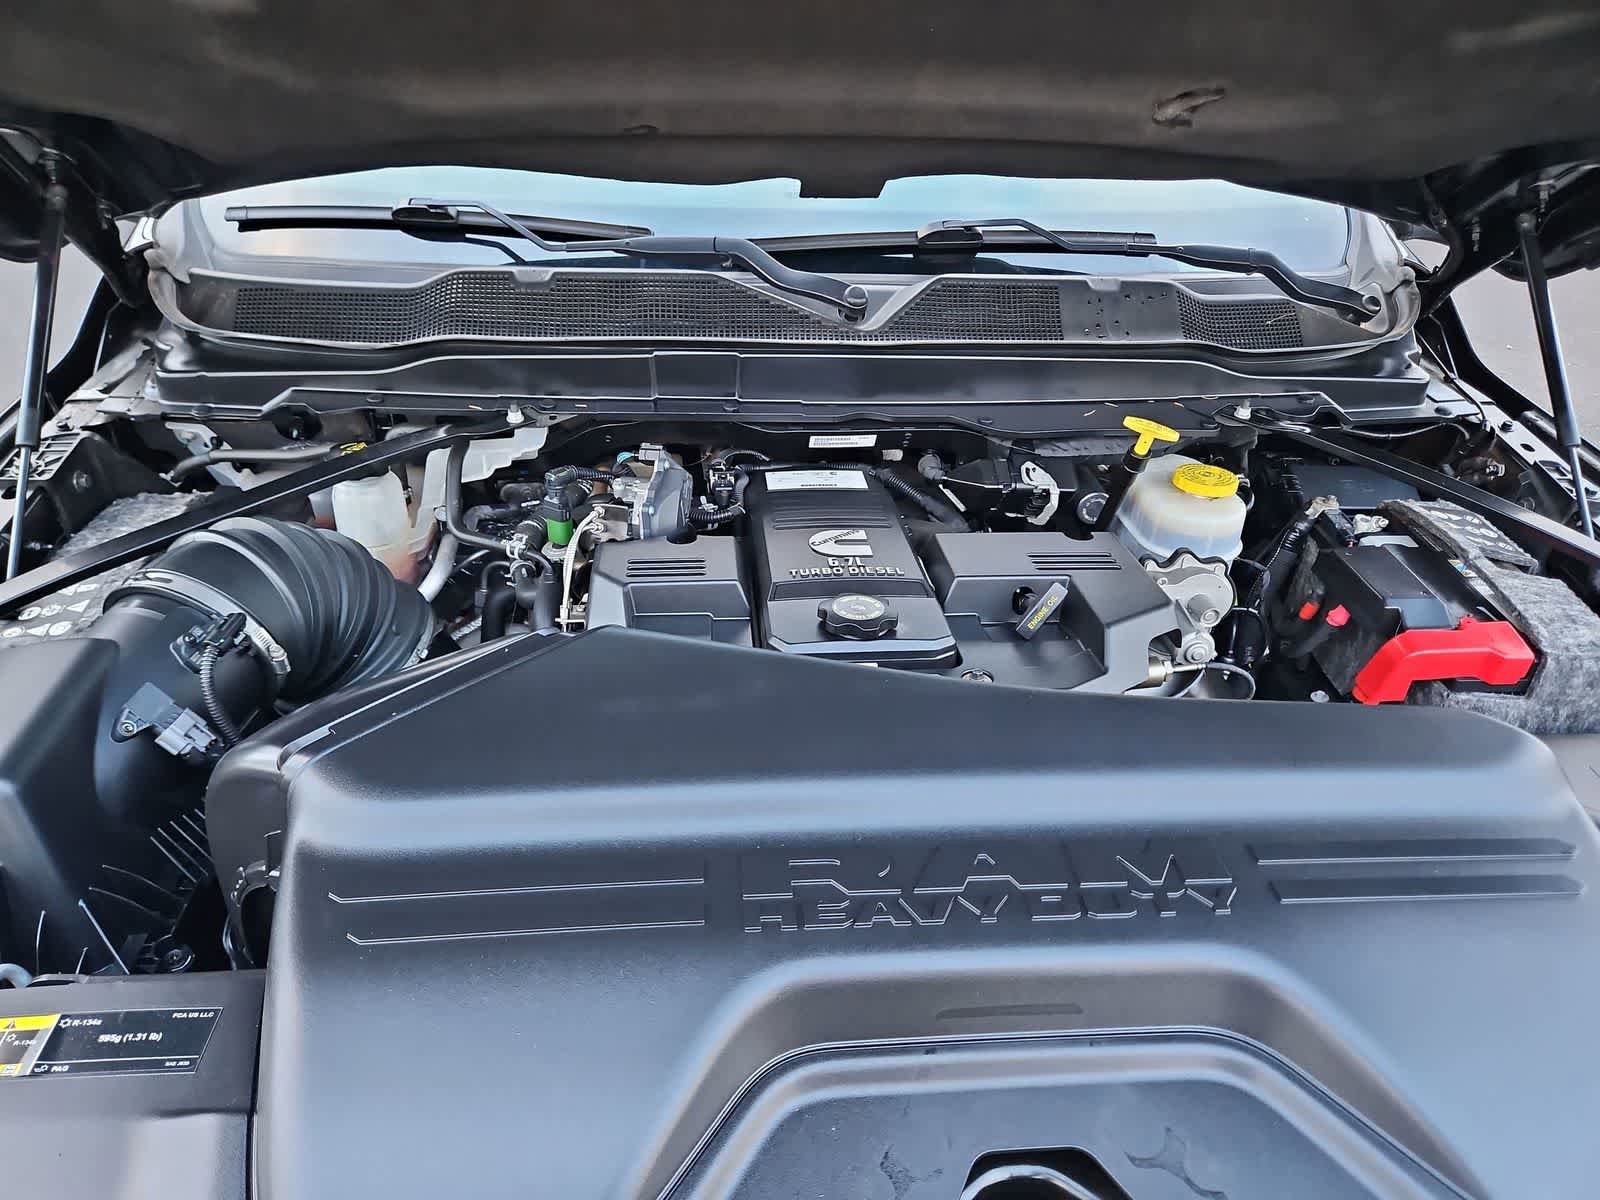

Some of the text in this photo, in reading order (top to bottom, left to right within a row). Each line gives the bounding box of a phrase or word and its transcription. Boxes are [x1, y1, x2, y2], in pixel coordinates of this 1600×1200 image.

[828, 557, 865, 567] 6.7L
[790, 566, 905, 578] TURBO DIESEL
[1027, 606, 1048, 629] ENGINE
[73, 1019, 103, 1027] R-134a
